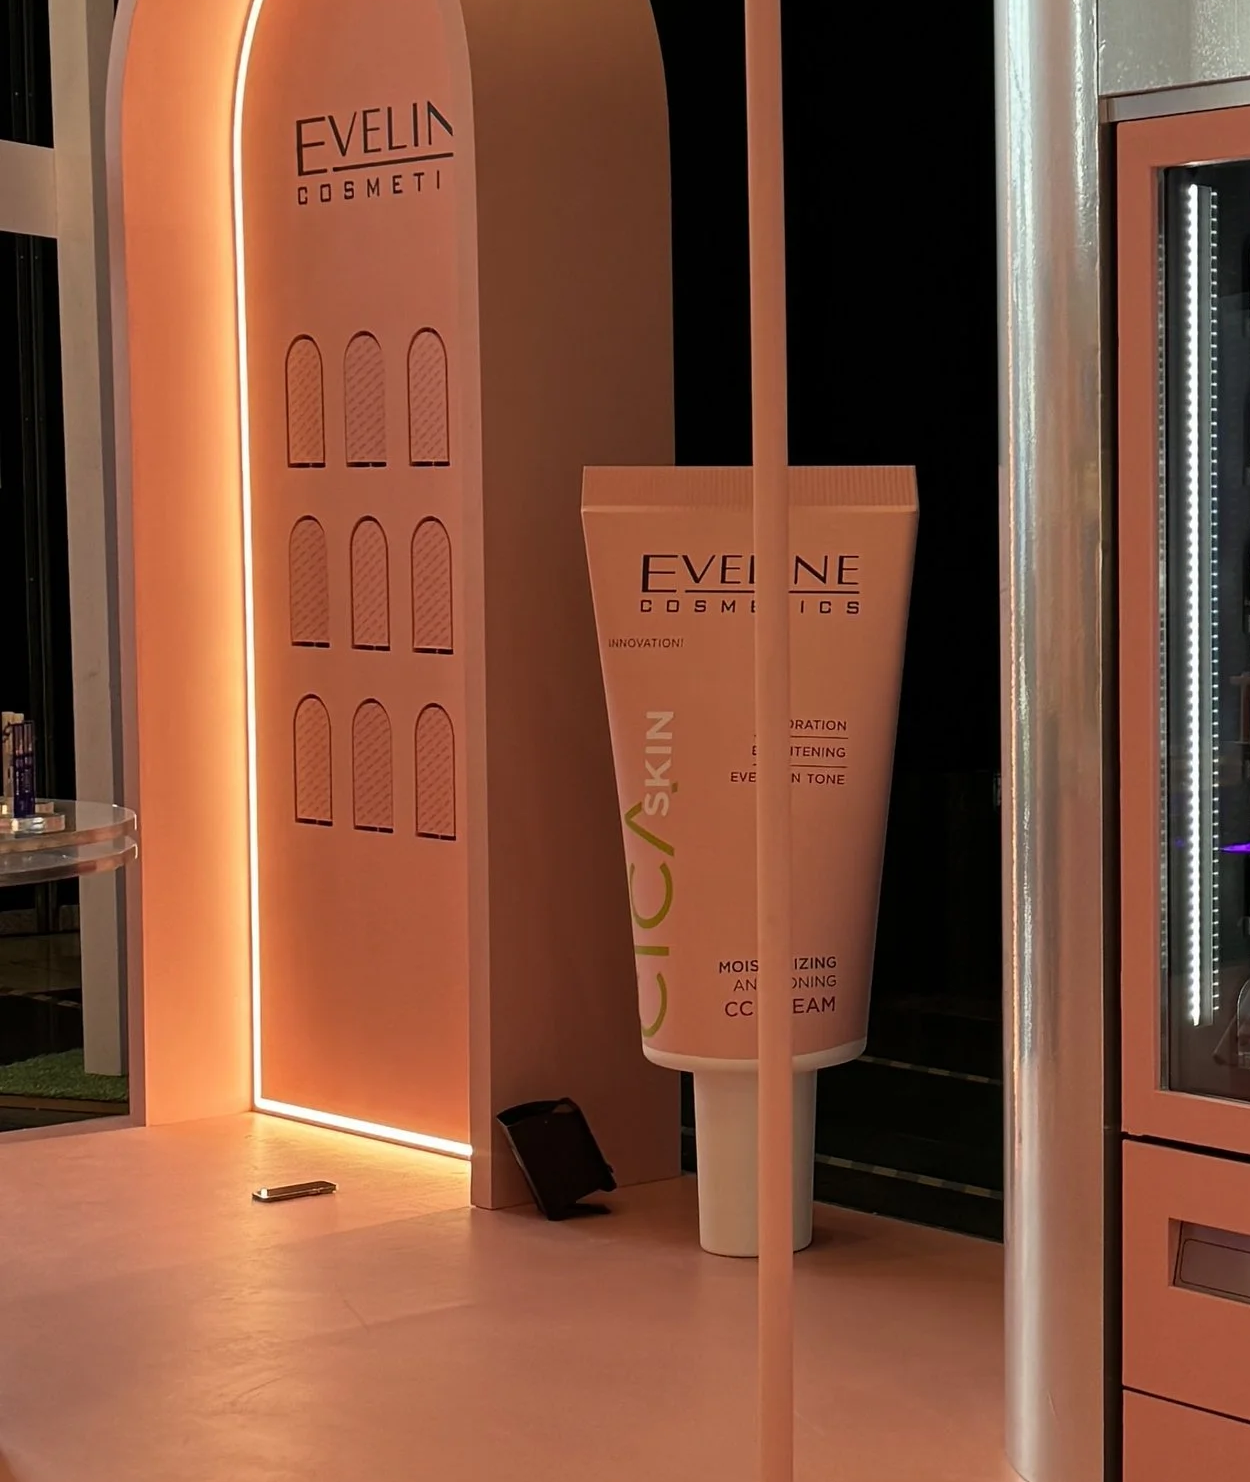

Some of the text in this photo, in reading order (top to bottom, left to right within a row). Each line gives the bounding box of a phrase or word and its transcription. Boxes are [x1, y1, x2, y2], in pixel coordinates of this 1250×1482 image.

[296, 100, 454, 177] EVELIN
[297, 169, 441, 206] COSMETI
[640, 554, 860, 593] EVELNE
[639, 599, 860, 615] COSMICS
[608, 638, 684, 649] INNOVATION!
[789, 718, 848, 731] RATION
[643, 710, 676, 817] SKIN
[730, 772, 757, 783] EVE
[807, 773, 846, 785] TONE
[718, 956, 837, 974] MOISIZING
[733, 975, 837, 992] AN NING
[724, 996, 836, 1017] CC EAM
